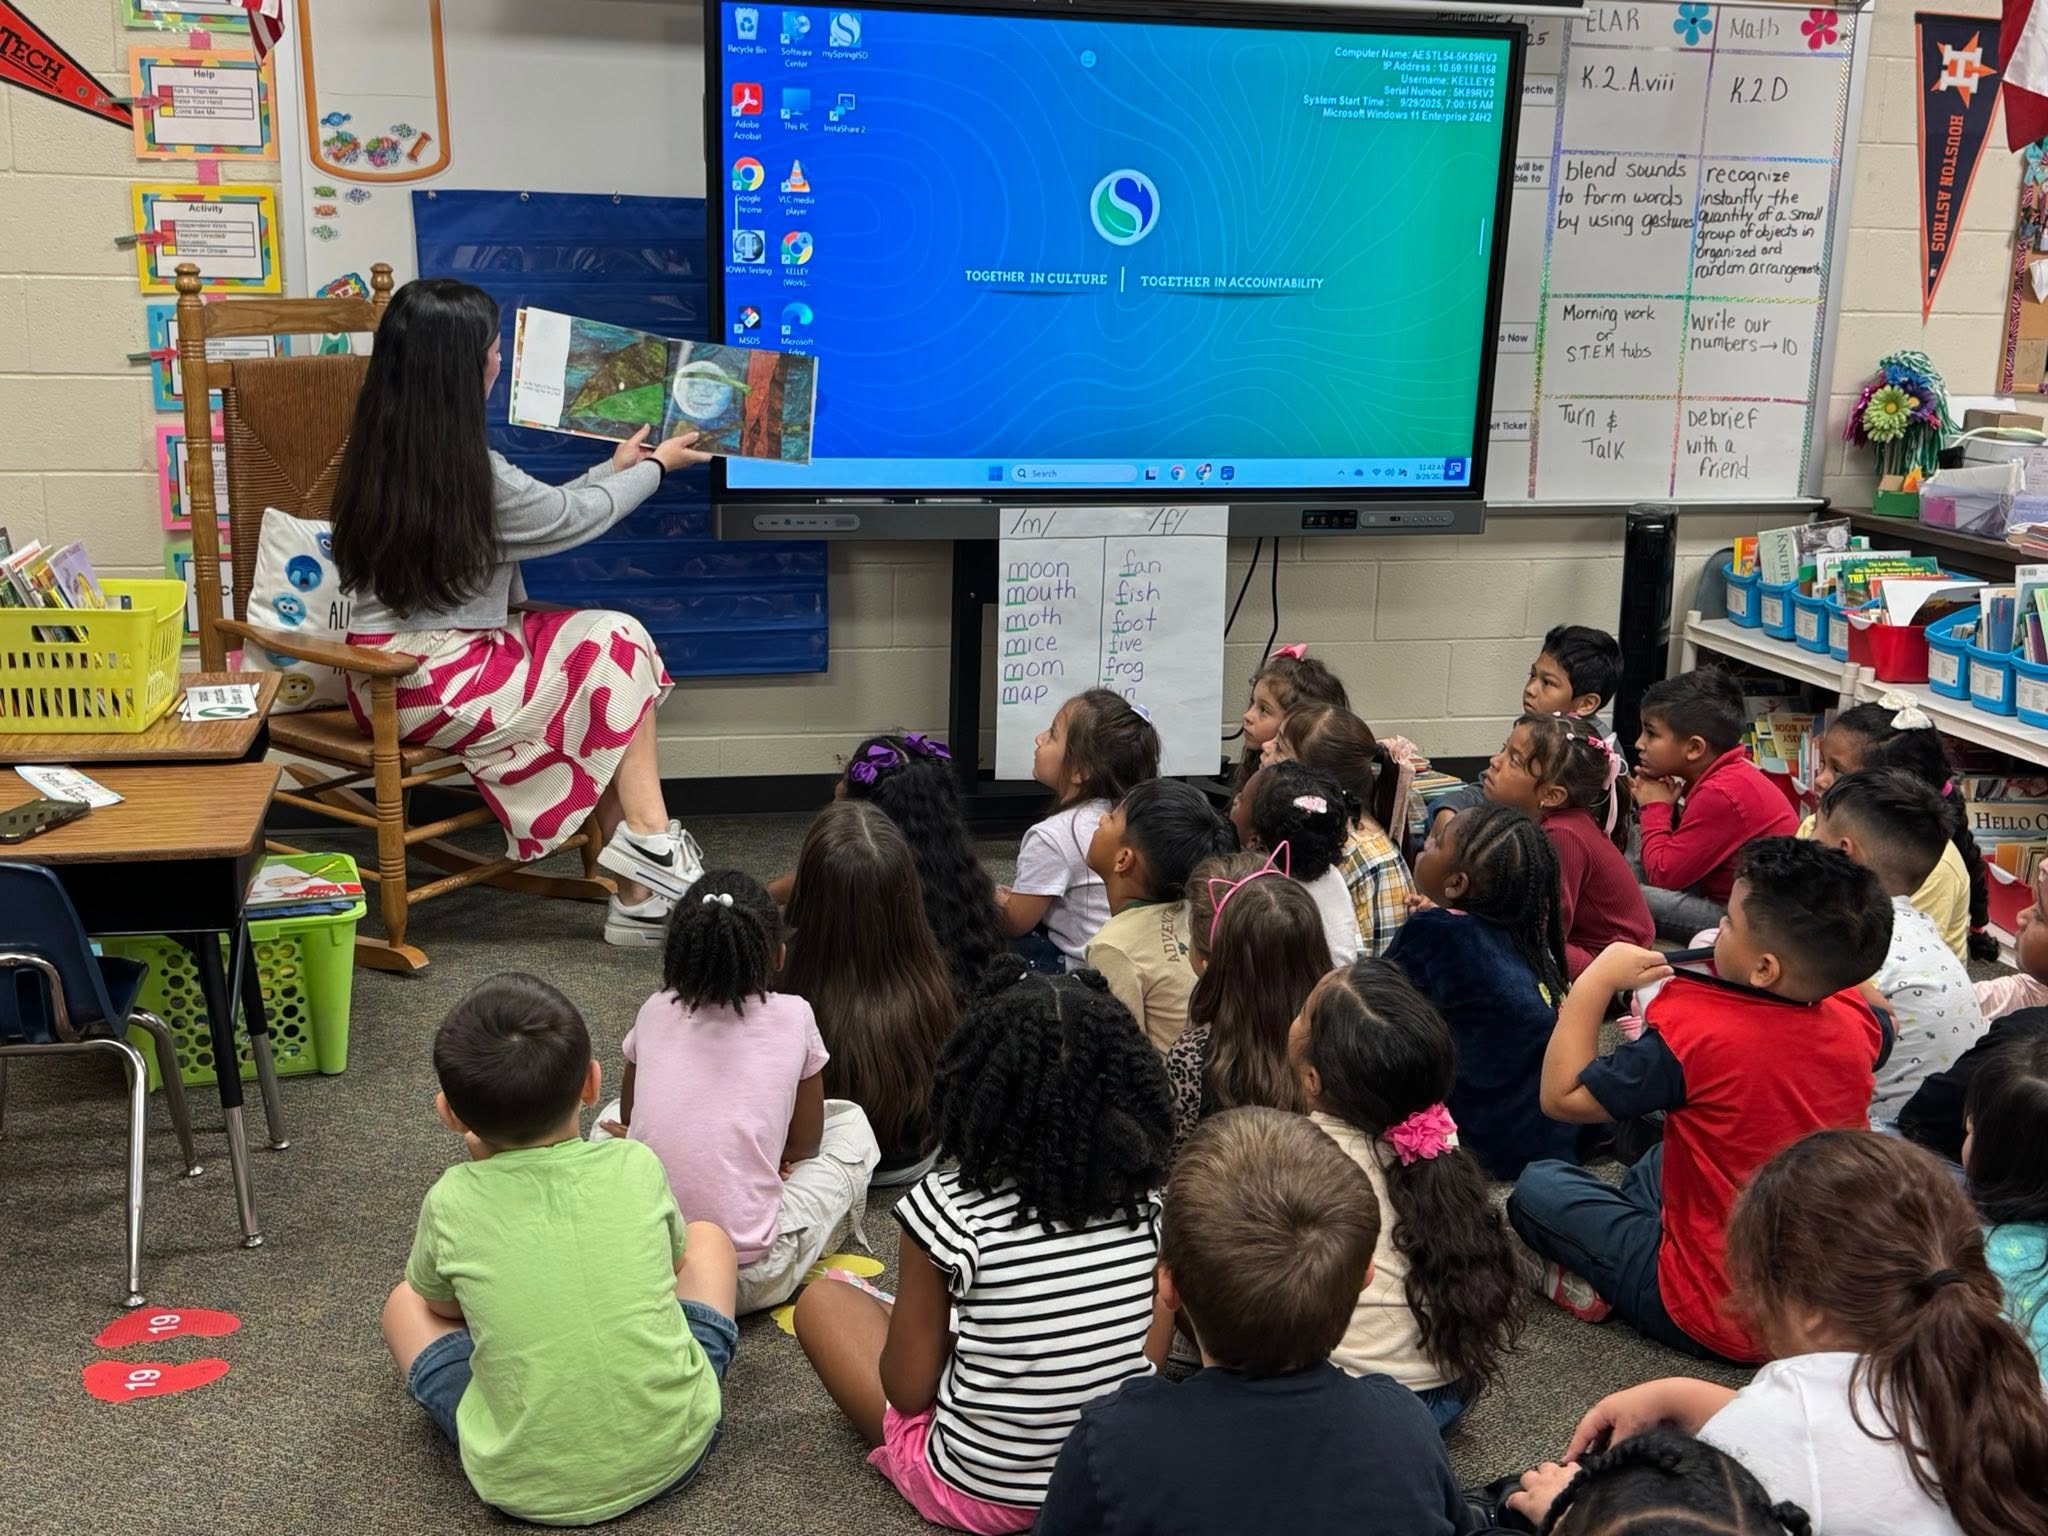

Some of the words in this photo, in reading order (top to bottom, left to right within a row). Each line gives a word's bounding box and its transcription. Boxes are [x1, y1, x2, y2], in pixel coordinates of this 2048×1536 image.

[1586, 8, 1640, 32] ELAR
[1729, 17, 1780, 40] Math
[0, 25, 65, 81] TECH
[727, 44, 755, 54] Recycle
[755, 46, 767, 54] Bin
[781, 48, 813, 57] Software
[822, 50, 869, 61] mySpringISD
[1334, 46, 1380, 59] Computer
[1381, 48, 1410, 59] Name:
[784, 59, 808, 68] Center
[1383, 61, 1393, 70] IP
[1393, 61, 1431, 72] Address
[193, 69, 215, 80] Help
[1401, 73, 1449, 85] Username:
[1384, 85, 1409, 95] Serial
[1410, 86, 1447, 96] Number
[1730, 76, 1788, 104] K.2.D
[1303, 94, 1336, 106] System
[1339, 95, 1360, 106] Start
[1362, 96, 1384, 106] Time
[1479, 100, 1494, 110] AM
[1323, 107, 1365, 118] Microsoft
[1366, 108, 1408, 119] Windows
[1410, 110, 1420, 120] 11
[1422, 111, 1467, 123] Enterprise
[1469, 112, 1493, 122] 24H2
[735, 120, 760, 129] Adobe
[784, 122, 798, 131] This
[799, 122, 809, 131] PC
[823, 124, 860, 134] InstaShare
[861, 126, 866, 134] 2
[733, 131, 762, 140] Acrobat
[1939, 114, 1964, 187] HOUSTON
[1515, 163, 1530, 172] will
[1532, 163, 1544, 172] be
[1566, 157, 1617, 181] blend
[1626, 159, 1687, 178] sounds
[1514, 173, 1530, 183] ble
[1531, 174, 1541, 183] to
[1706, 167, 1791, 190] recognize
[779, 196, 792, 204] VLC
[793, 196, 815, 205] media
[1558, 186, 1574, 206] to
[1584, 183, 1626, 206] form
[1633, 184, 1683, 206] words
[1768, 189, 1799, 206] the
[188, 204, 224, 214] Activity
[738, 205, 763, 214] hrome
[785, 207, 807, 216] player
[1698, 206, 1754, 227] quantity
[1758, 206, 1775, 221] of
[1775, 210, 1787, 221] a
[1788, 206, 1824, 221] small
[1557, 210, 1580, 236] by
[1589, 213, 1634, 236] using
[1641, 210, 1695, 236] gestures
[1931, 190, 1952, 252] ASTROS
[1697, 226, 1736, 247] group
[1739, 223, 1756, 238] of
[1755, 224, 1798, 241] objects
[1802, 225, 1815, 238] in
[1695, 245, 1757, 264] organized
[1761, 240, 1783, 256] and
[726, 266, 746, 274] IOWA
[748, 266, 772, 276] Testing
[965, 270, 1025, 283] TOGETHER
[1029, 272, 1045, 284] IN
[1047, 272, 1108, 285] CULTURE
[1694, 260, 1746, 279] random
[1140, 275, 1211, 288] TOGETHER
[1214, 276, 1227, 288] IN
[1229, 276, 1325, 289] ACCOUNTABILITY
[1562, 304, 1618, 331] Morning
[1624, 305, 1655, 320] work
[1744, 318, 1772, 333] our
[738, 337, 760, 345] MSDS
[781, 337, 814, 346] Microsoft
[1507, 333, 1528, 343] Now
[1596, 331, 1614, 342] or
[1620, 341, 1652, 359] tubs
[1782, 337, 1798, 356] 10
[1489, 421, 1501, 430] xit
[1503, 421, 1527, 430] Ticket
[1558, 403, 1596, 428] Turn
[1606, 409, 1618, 433] &
[1688, 408, 1759, 430] Debrief
[1686, 436, 1717, 455] with
[1725, 439, 1736, 453] a
[1032, 469, 1058, 479] Search
[1010, 510, 1057, 538] /m/
[1148, 507, 1189, 535] /f/
[1007, 561, 1070, 580] moon
[1122, 549, 1162, 575] fan
[1847, 574, 1865, 584] THE
[1007, 579, 1076, 603] mouth
[1115, 580, 1161, 602] fish
[1006, 607, 1062, 629] moth
[1112, 607, 1158, 633] foot
[1005, 635, 1057, 654] mice
[1109, 633, 1144, 652] five
[1004, 658, 1065, 678] mom
[1105, 656, 1144, 682] frog
[1003, 685, 1049, 704] map
[148, 1315, 181, 1334] 19
[124, 1369, 161, 1391] 19
